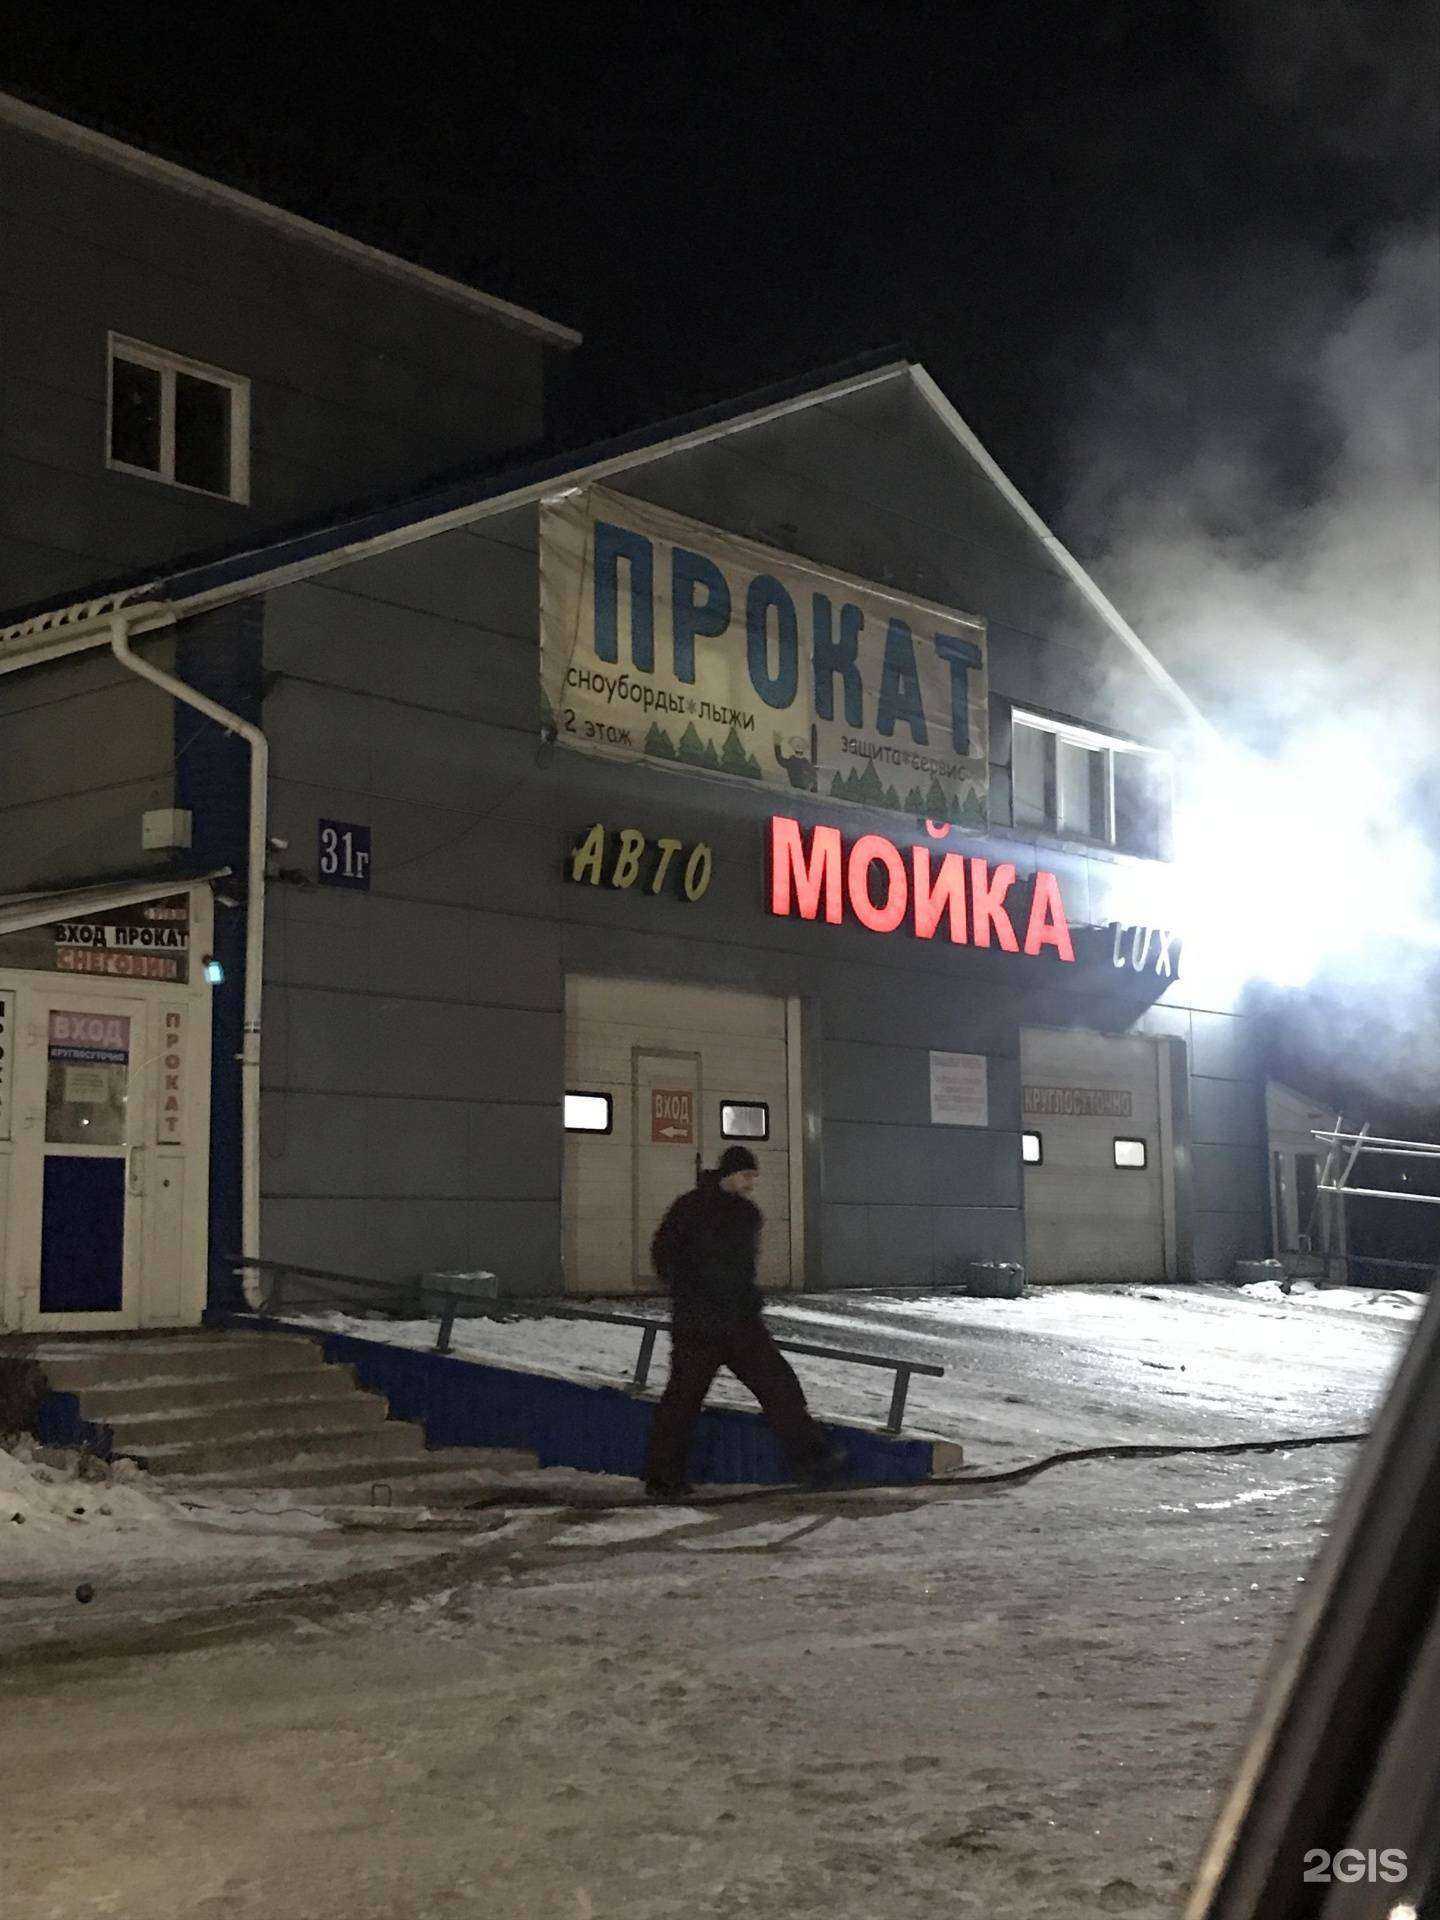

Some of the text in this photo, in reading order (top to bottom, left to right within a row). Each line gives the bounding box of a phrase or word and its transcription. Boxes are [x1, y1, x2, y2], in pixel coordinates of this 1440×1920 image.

[594, 519, 983, 757] ПРОКАТ
[566, 668, 755, 732] сноуборды лыжи
[563, 708, 632, 747] 2 этаж
[840, 735, 967, 783] защита сервис
[321, 828, 369, 879] 31г
[571, 815, 1184, 979] АВТО МОЙКА LUX
[55, 924, 190, 948] ВХОД ПРОКАТ
[54, 1015, 122, 1047] ВХОД
[165, 1012, 181, 1133] ПРОКАТ
[655, 1093, 689, 1126] ВХОД
